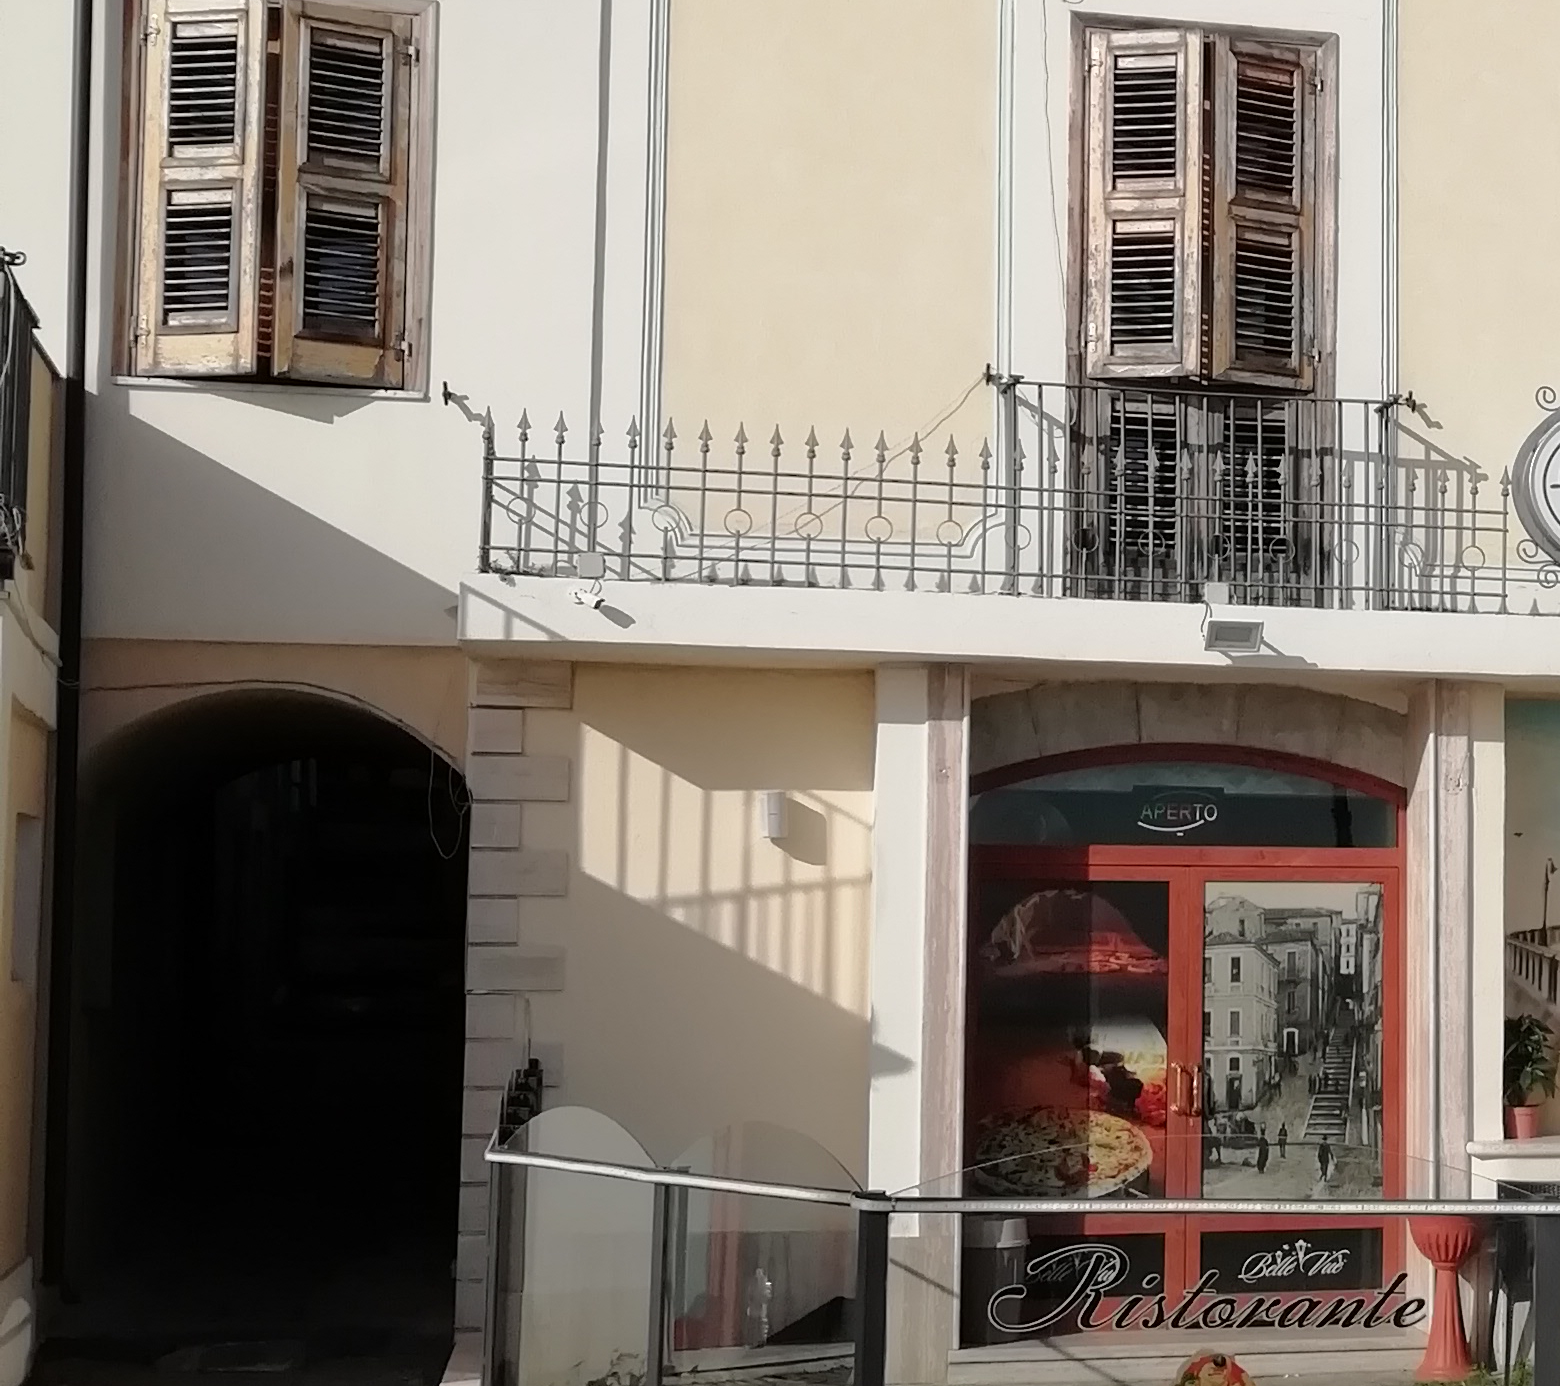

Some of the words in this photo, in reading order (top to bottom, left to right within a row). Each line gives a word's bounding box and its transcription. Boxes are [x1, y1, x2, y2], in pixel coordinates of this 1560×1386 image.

[1140, 803, 1218, 821] APERTO
[1238, 1252, 1298, 1283] Belle
[988, 1242, 1427, 1333] Ristorante
